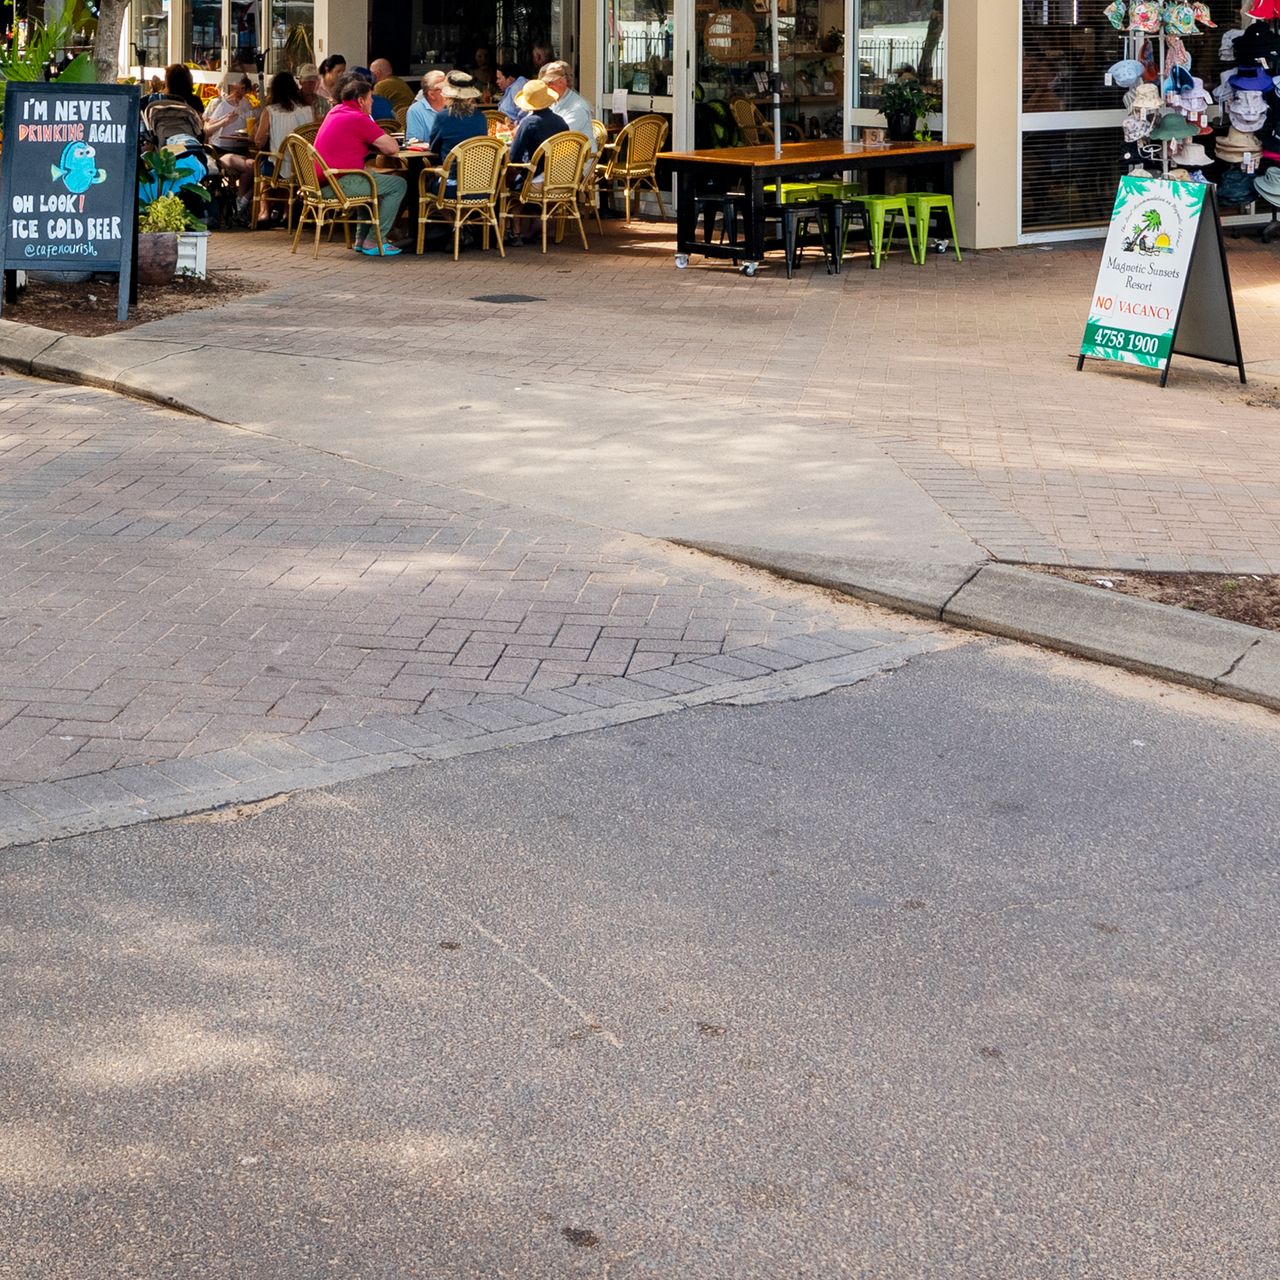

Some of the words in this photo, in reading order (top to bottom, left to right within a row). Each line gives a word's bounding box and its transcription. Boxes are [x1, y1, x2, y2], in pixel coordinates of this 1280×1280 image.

[23, 98, 48, 121] I'M
[55, 100, 112, 121] NEVER
[19, 123, 85, 142] DRINKING
[88, 123, 127, 143] AGAIN
[12, 195, 34, 213] OH
[12, 219, 39, 239] ICE
[47, 218, 84, 239] COLD
[87, 216, 122, 240] BEER
[1107, 256, 1146, 274] Magnetic
[1147, 261, 1180, 278] Sunsets
[1125, 275, 1152, 292] Resort
[1095, 296, 1113, 310] NO
[1118, 300, 1173, 320] VACANCY
[1094, 328, 1125, 348] 4758
[1127, 334, 1159, 354] 1900
